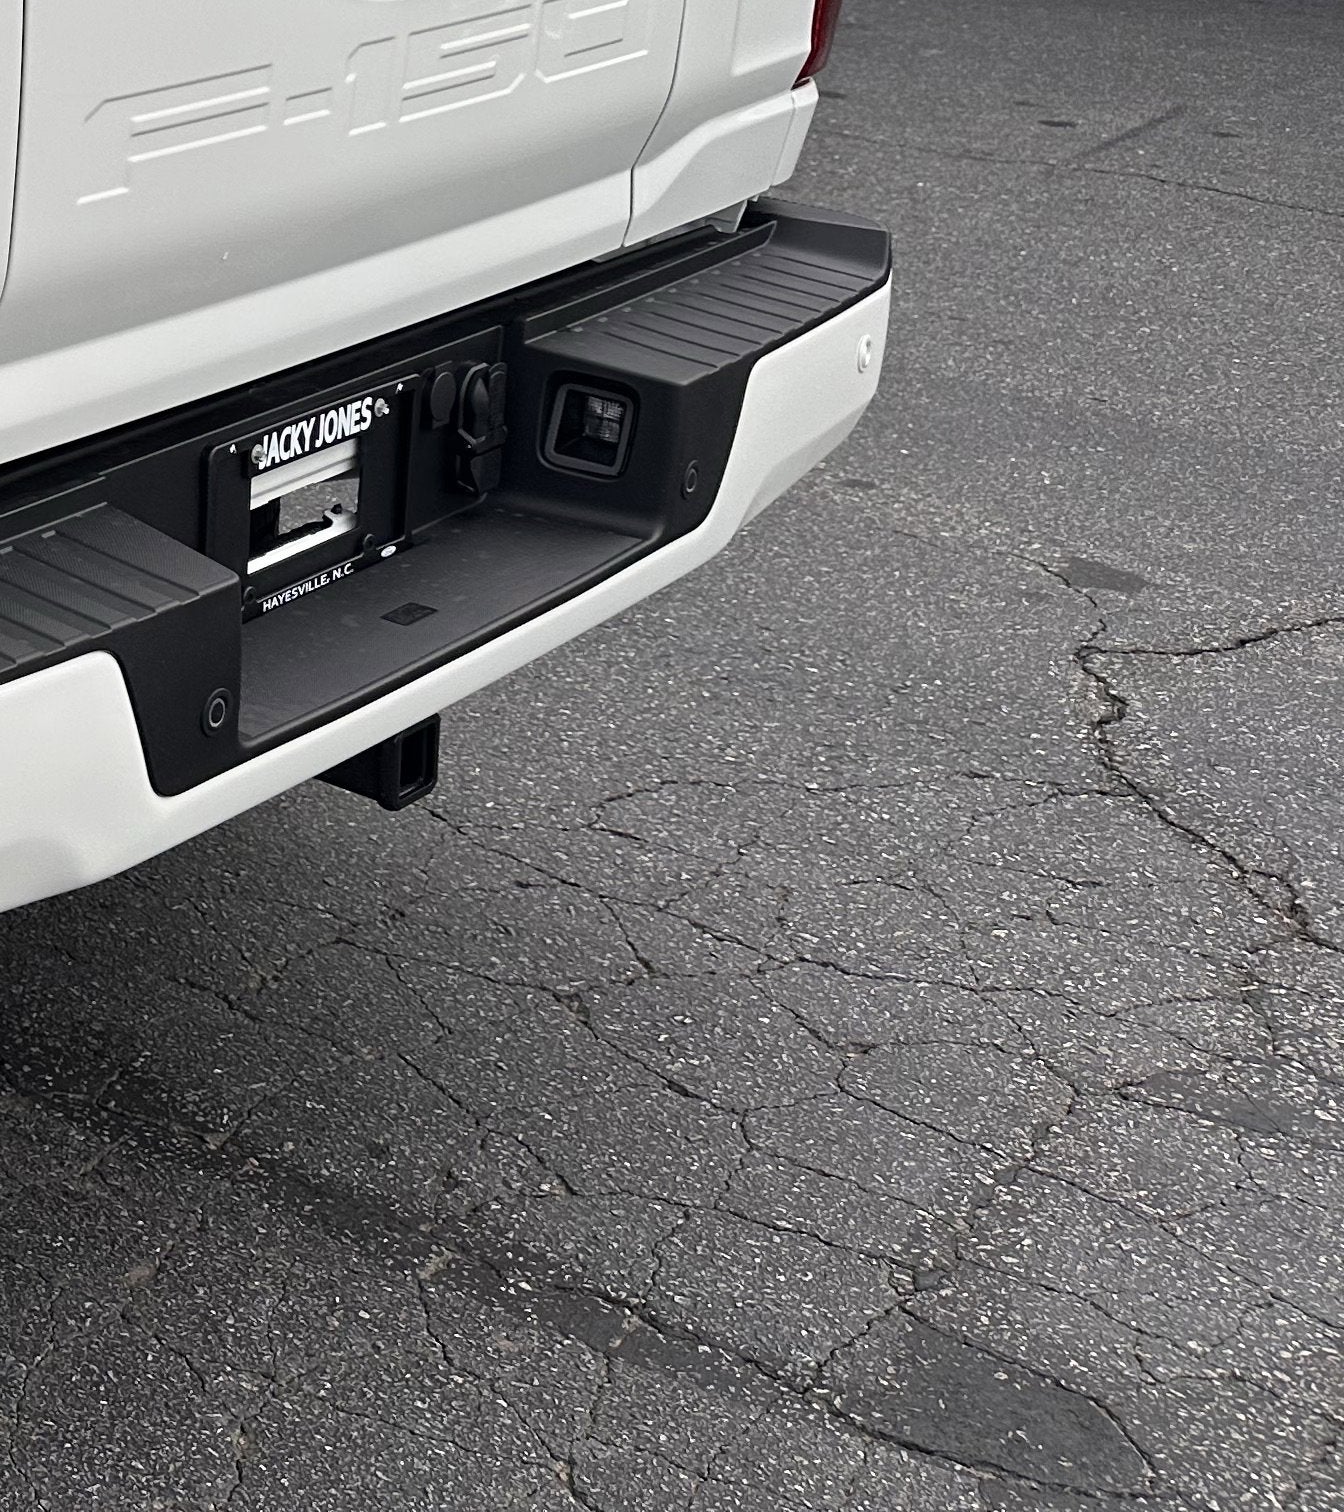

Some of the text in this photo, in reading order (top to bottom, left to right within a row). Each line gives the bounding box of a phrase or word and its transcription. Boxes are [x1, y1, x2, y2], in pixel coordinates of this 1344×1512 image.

[258, 396, 373, 470] JACKY JONES
[262, 562, 354, 613] HAYESVILLE, N.C.
